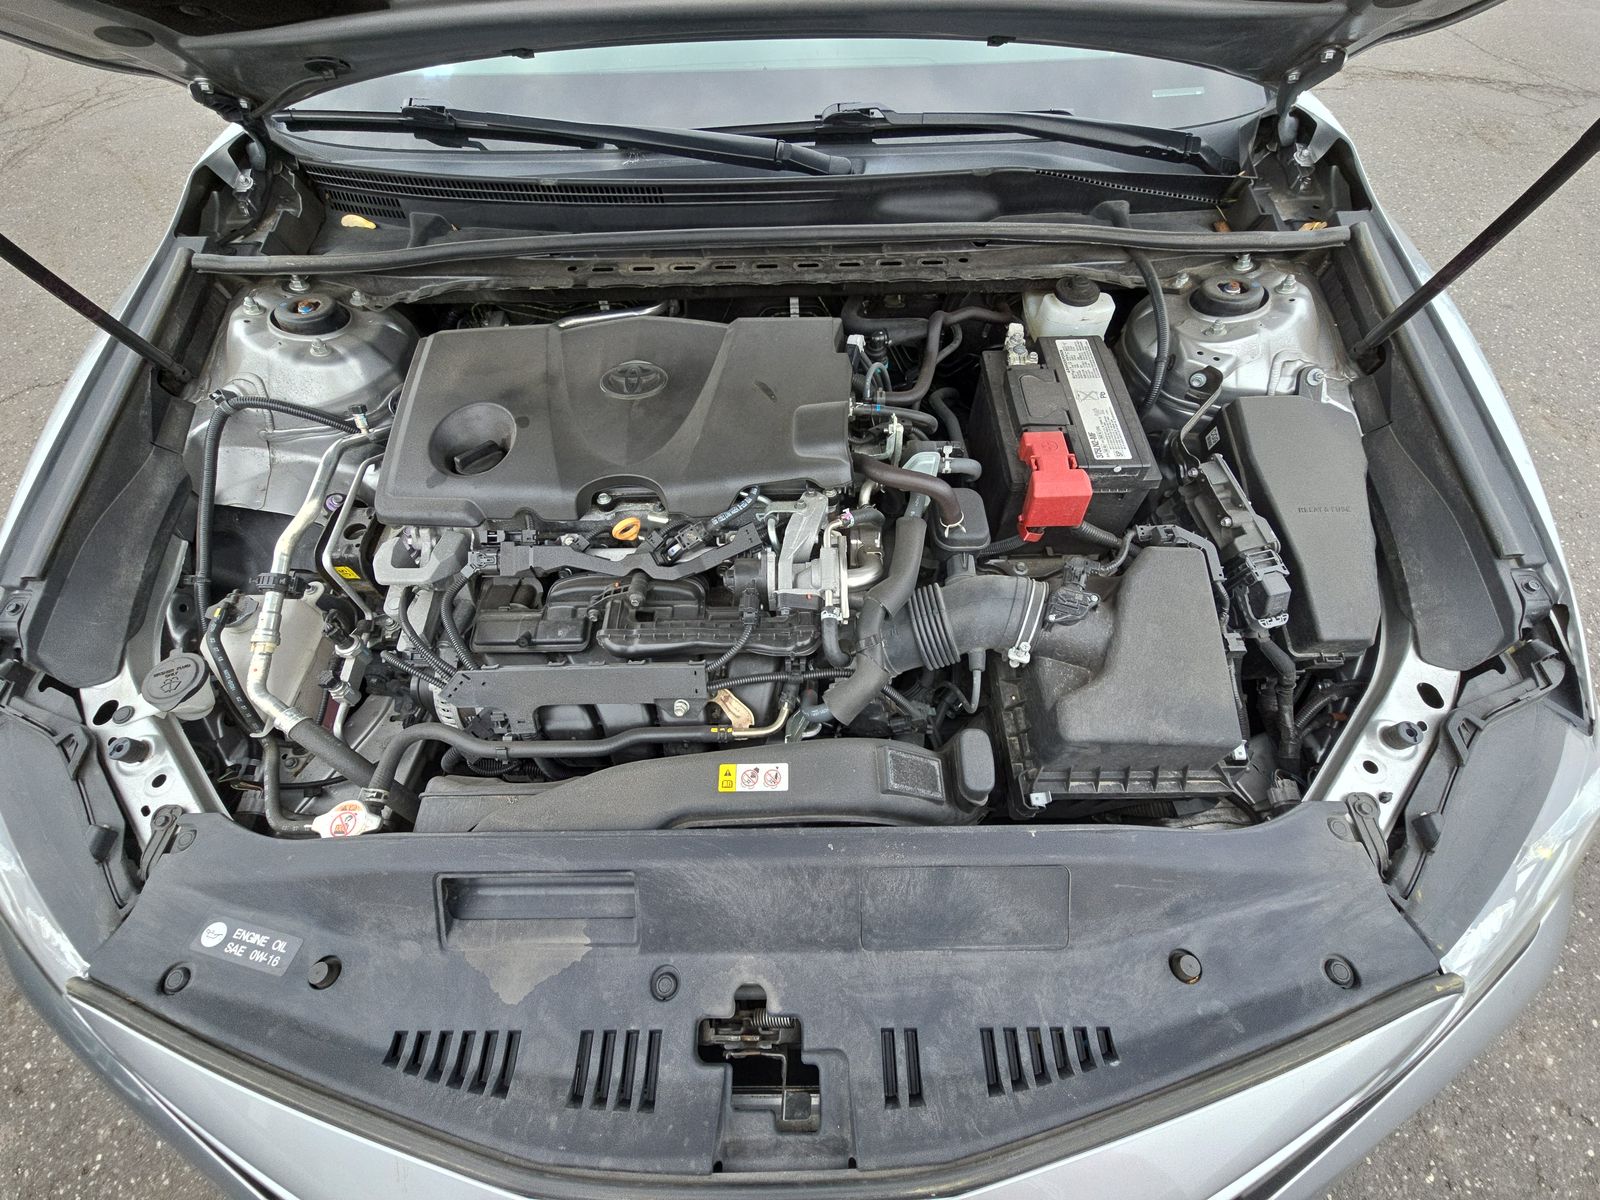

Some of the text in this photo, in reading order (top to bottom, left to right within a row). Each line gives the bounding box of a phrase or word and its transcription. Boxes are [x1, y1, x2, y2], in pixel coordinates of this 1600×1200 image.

[232, 928, 288, 954] ENGINE OIL
[224, 942, 281, 967] SAE 0W-16
